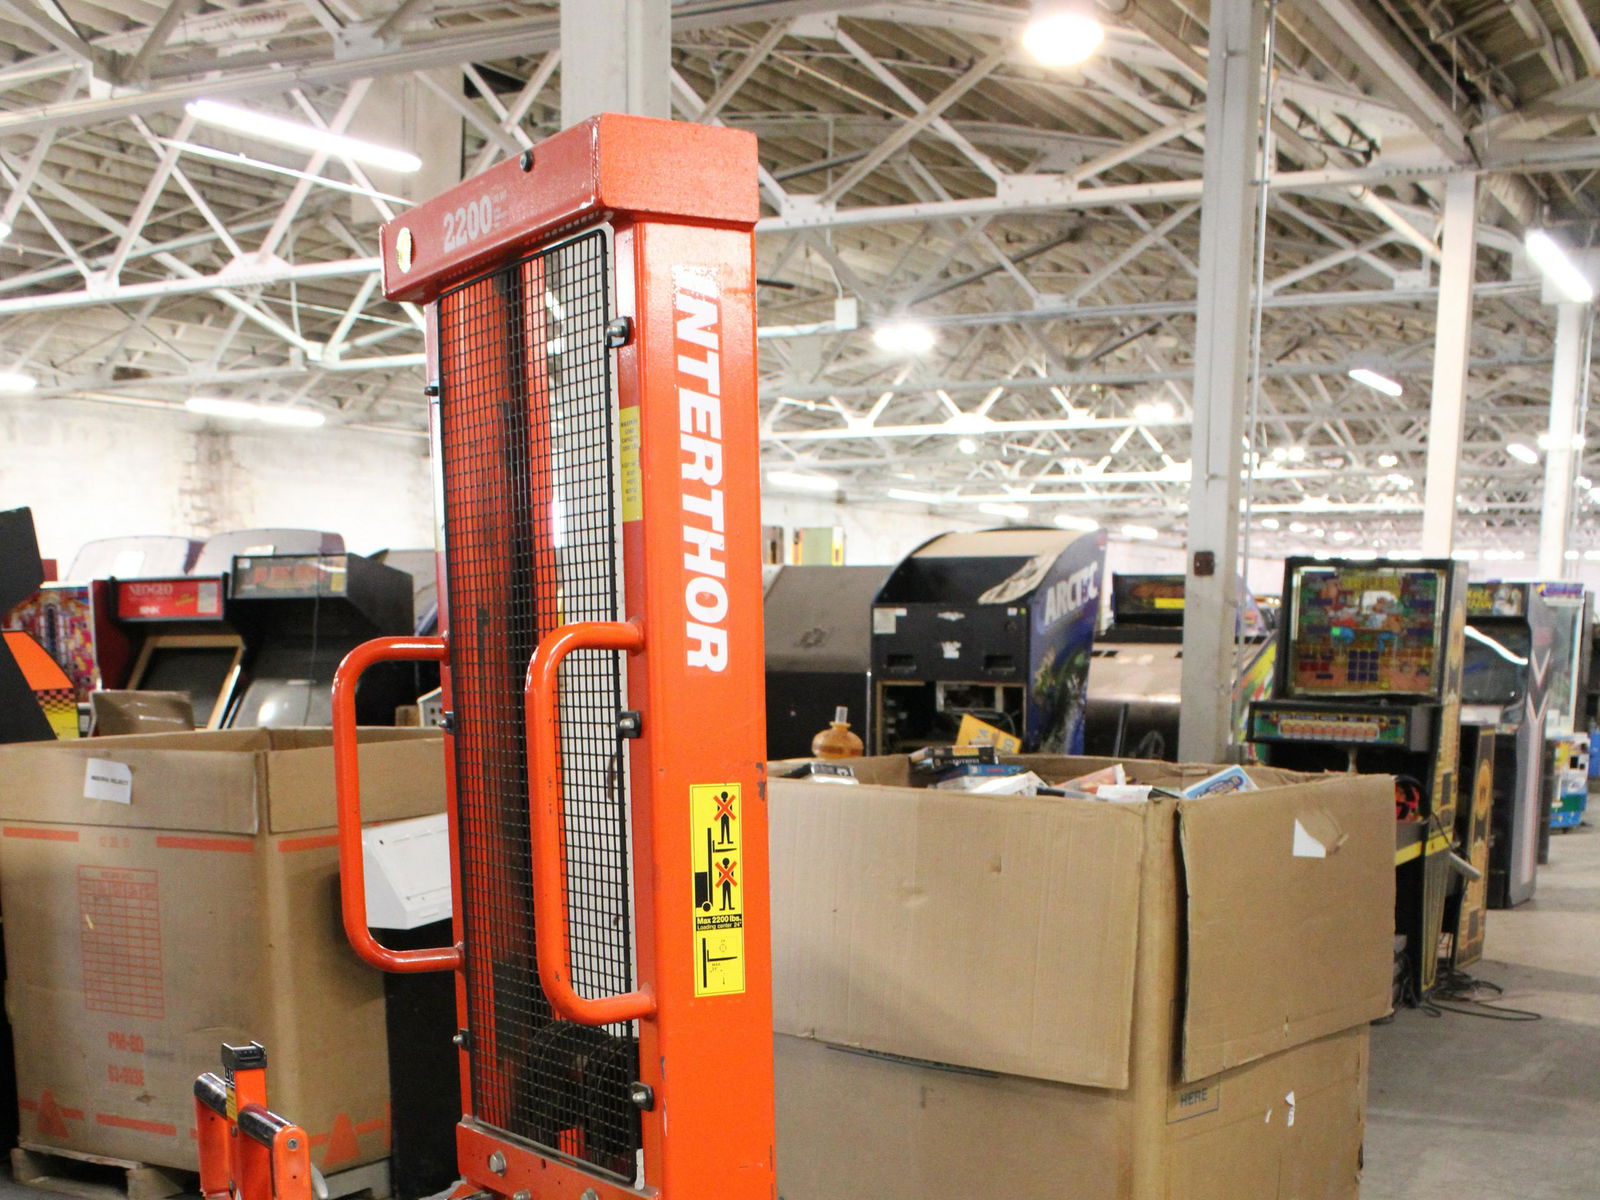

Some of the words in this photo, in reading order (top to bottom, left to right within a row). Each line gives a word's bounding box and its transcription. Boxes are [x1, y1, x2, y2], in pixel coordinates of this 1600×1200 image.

[443, 194, 492, 254] 2200
[672, 266, 729, 673] INTERTHOR
[697, 916, 711, 925] Max
[711, 915, 729, 924] 2200
[1180, 1086, 1208, 1108] HERE
